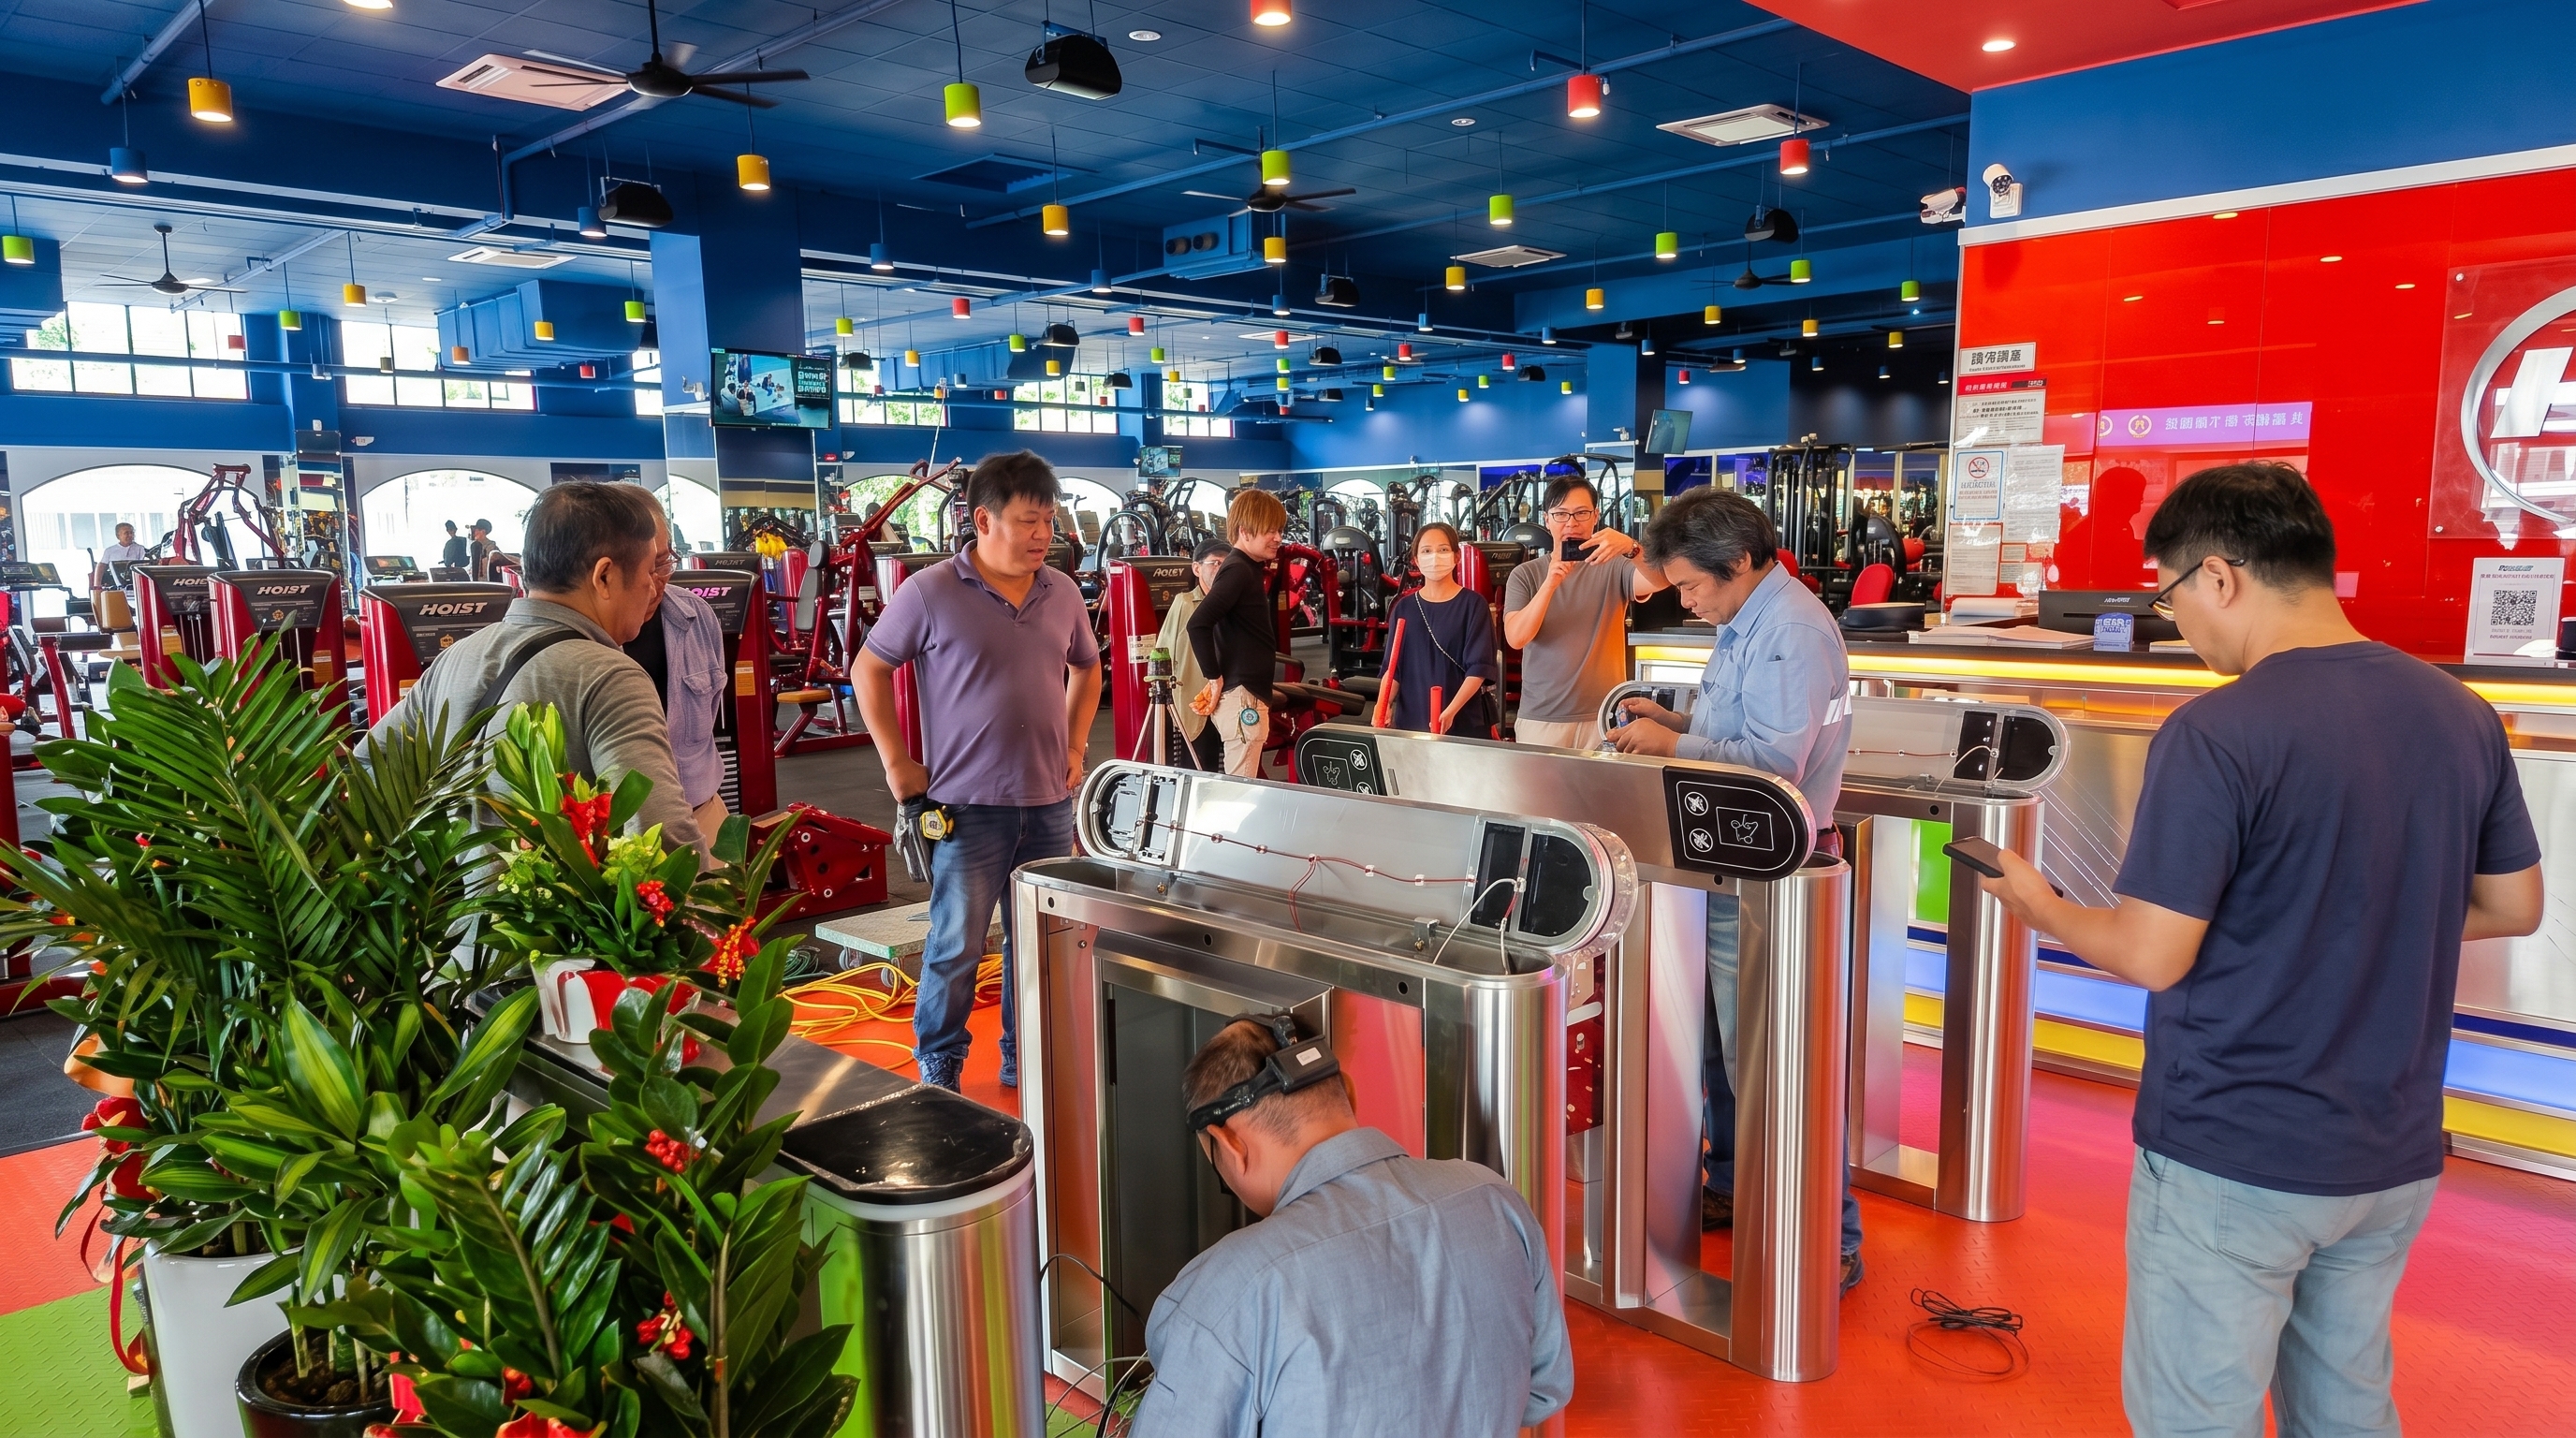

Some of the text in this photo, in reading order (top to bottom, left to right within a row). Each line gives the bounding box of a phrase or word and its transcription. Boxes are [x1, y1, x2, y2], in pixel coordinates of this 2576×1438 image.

[172, 578, 208, 586] HOIS
[256, 584, 310, 595] HOIST
[687, 586, 731, 597] OIST
[418, 601, 488, 615] HOIST
